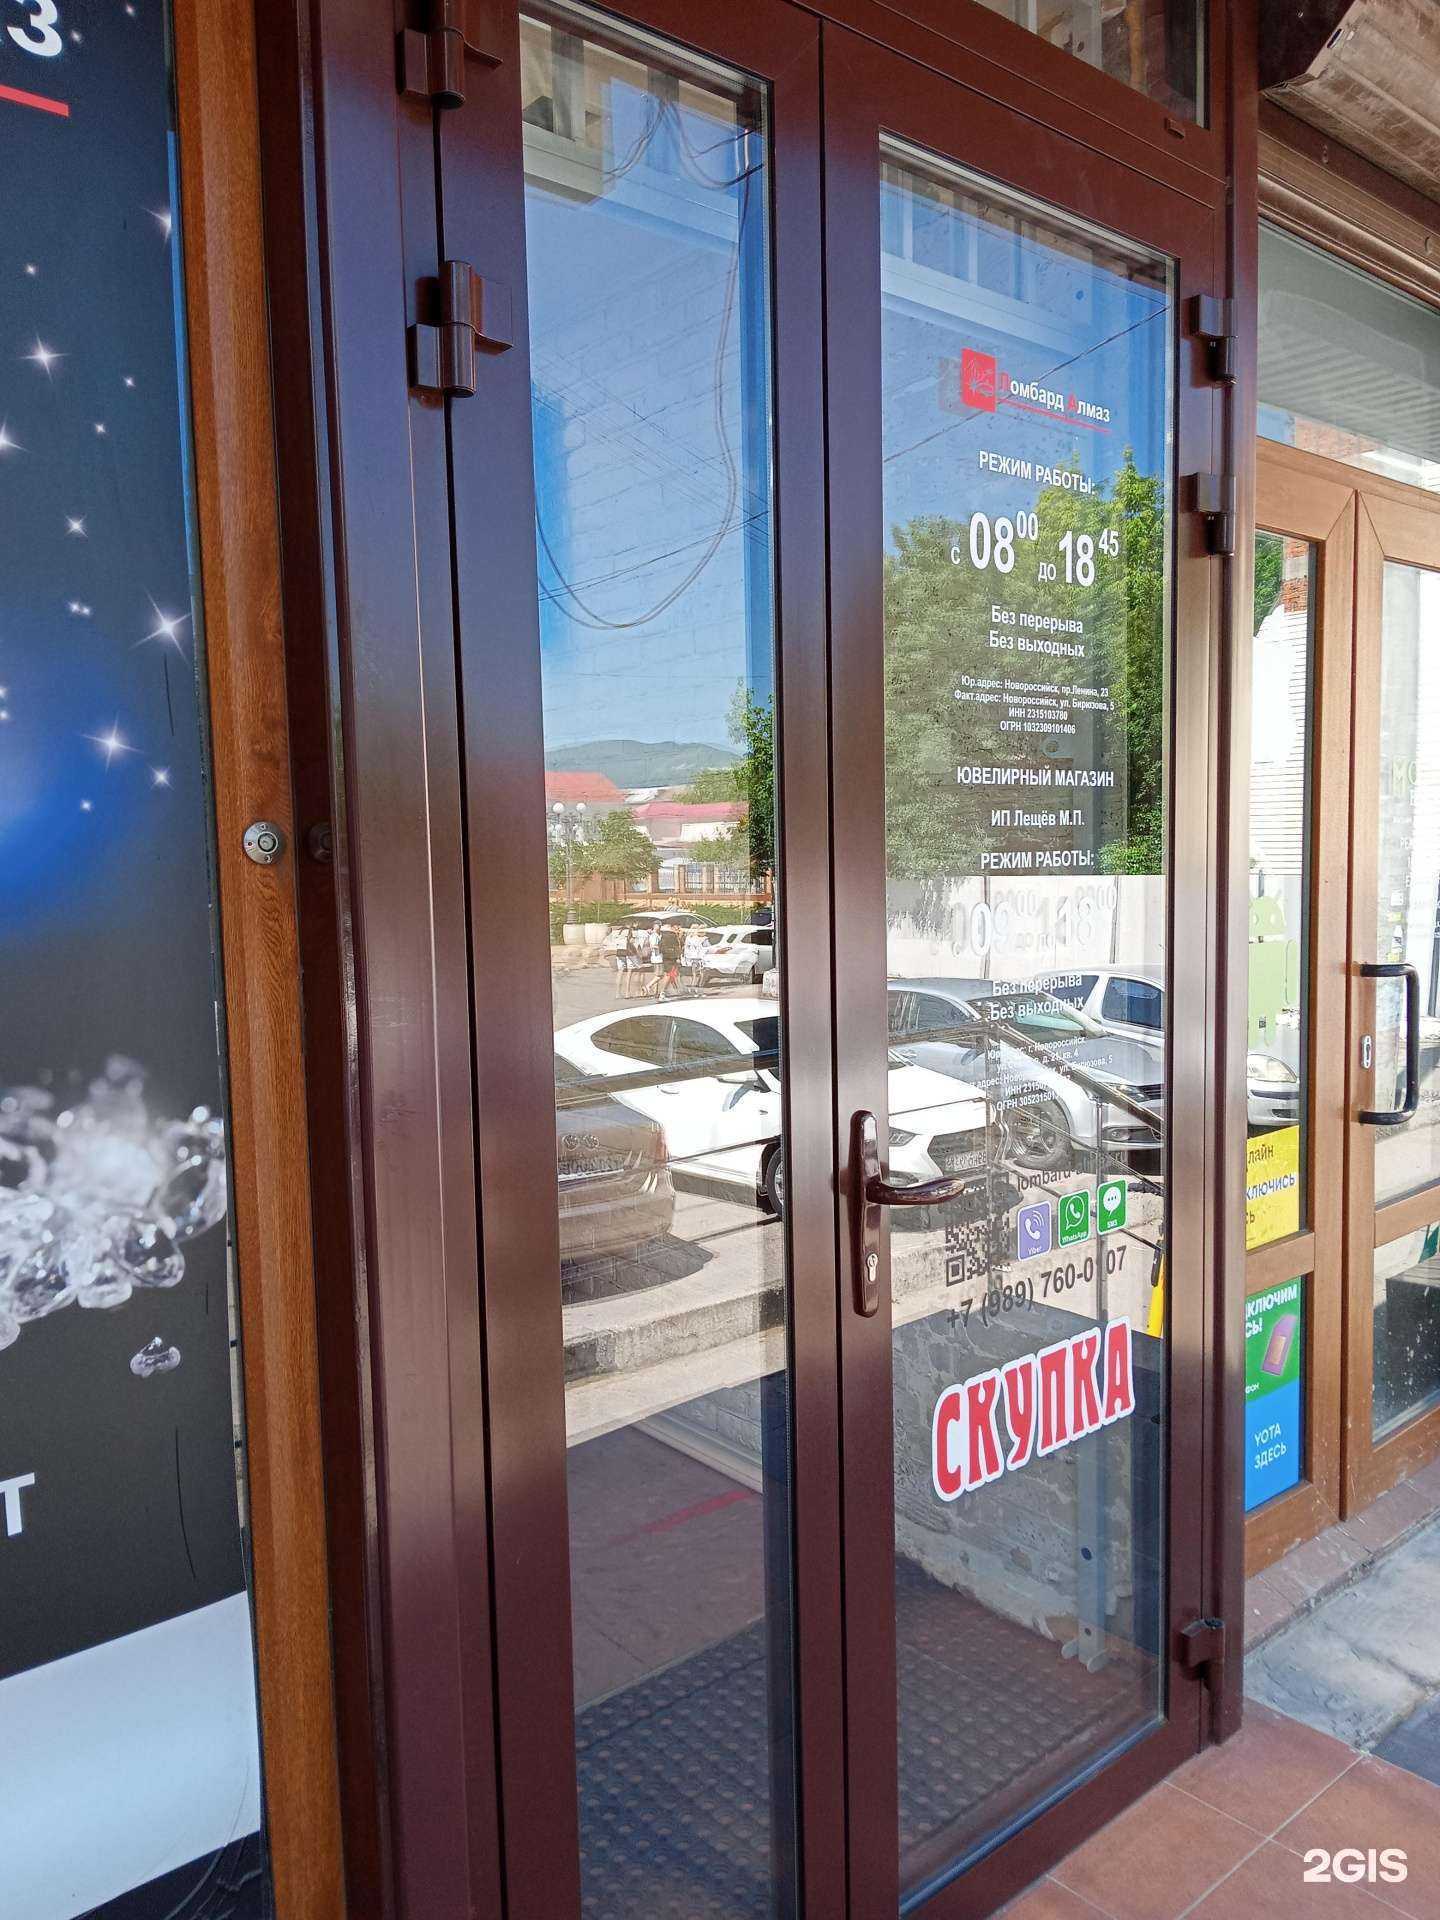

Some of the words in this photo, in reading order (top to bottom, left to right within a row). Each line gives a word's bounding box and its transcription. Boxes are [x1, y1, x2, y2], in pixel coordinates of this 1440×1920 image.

[1001, 371, 1065, 412] Ломбард
[1068, 393, 1111, 423] Алмаз
[979, 450, 1032, 480] РЕЖИМ
[1035, 463, 1096, 496] РАБОТЫ:
[969, 511, 1016, 574] 08
[1016, 510, 1039, 541] 00
[1038, 562, 1057, 582] до
[1058, 530, 1096, 587] 18
[1098, 528, 1120, 557] 45
[991, 604, 1016, 626] Без
[1019, 612, 1084, 634] перерыва
[989, 630, 1014, 651] Без
[1017, 637, 1086, 658] выходных
[1008, 707, 1026, 718] ИНН
[1000, 720, 1022, 731] ОГРН
[957, 766, 1051, 785] ЮВЕЛИРНЫЙ
[1055, 769, 1114, 787] МАГАЗИН
[991, 809, 1011, 827] ИП
[1059, 810, 1085, 826] М.П.
[981, 851, 1032, 870] РЕЖИМ
[1035, 848, 1095, 867] РАБОТЫ:
[992, 979, 1017, 997] Без
[1019, 974, 1083, 996] перерыва
[990, 1001, 1014, 1021] Без
[947, 1299, 973, 1328] +7
[980, 1278, 1034, 1327] (989)
[1040, 1246, 1127, 1298] 760-007
[1246, 1284, 1298, 1320] КЛЮЧИМ
[932, 1316, 1135, 1502] СКУПКА
[1254, 1423, 1281, 1446] YOTA
[1254, 1444, 1287, 1469] ЗДЕСЬ
